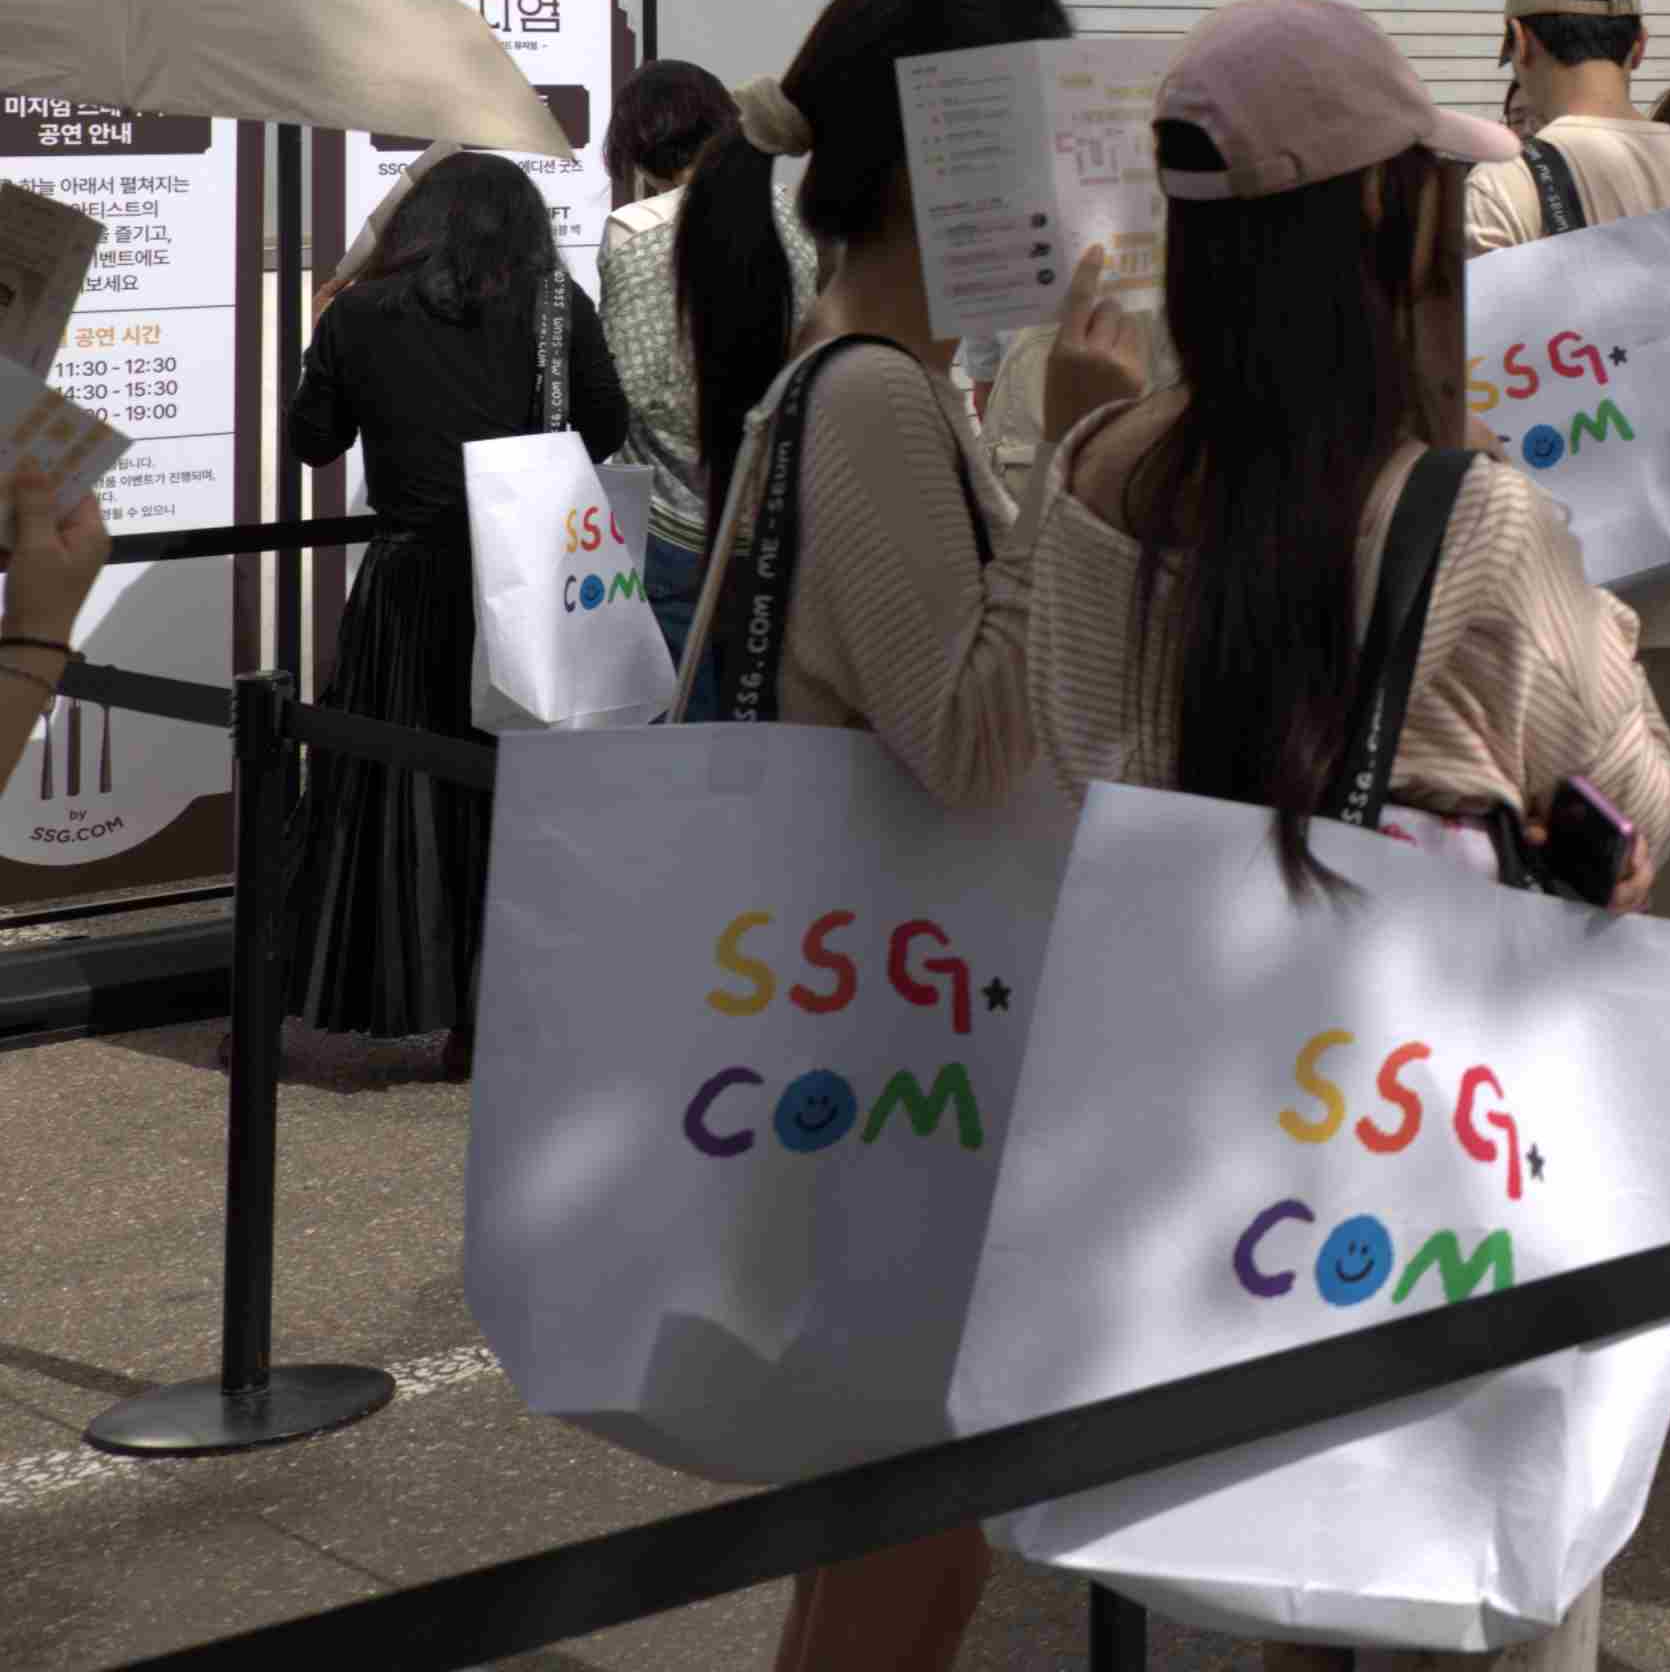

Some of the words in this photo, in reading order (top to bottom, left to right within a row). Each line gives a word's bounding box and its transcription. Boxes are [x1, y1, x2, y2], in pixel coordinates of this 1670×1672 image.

[38, 122, 82, 146] 공연
[88, 122, 132, 145] 안내
[61, 178, 115, 195] 아래서
[119, 176, 190, 194] 펼쳐지는
[115, 226, 172, 243] 즐기고,
[80, 275, 139, 293] 보세요
[75, 325, 116, 348] 공연
[122, 323, 161, 345] 시간
[55, 360, 108, 377] 11:30
[126, 357, 177, 374] 12:30
[126, 380, 178, 397] 15:30
[126, 403, 177, 421] 19:00
[1497, 399, 1635, 469] OM
[563, 567, 648, 613] COM
[730, 593, 775, 723] SSG.COM
[68, 809, 88, 821] by
[30, 816, 125, 844] SSG.COM
[683, 1061, 983, 1158] COM
[1233, 1198, 1515, 1307] COM
